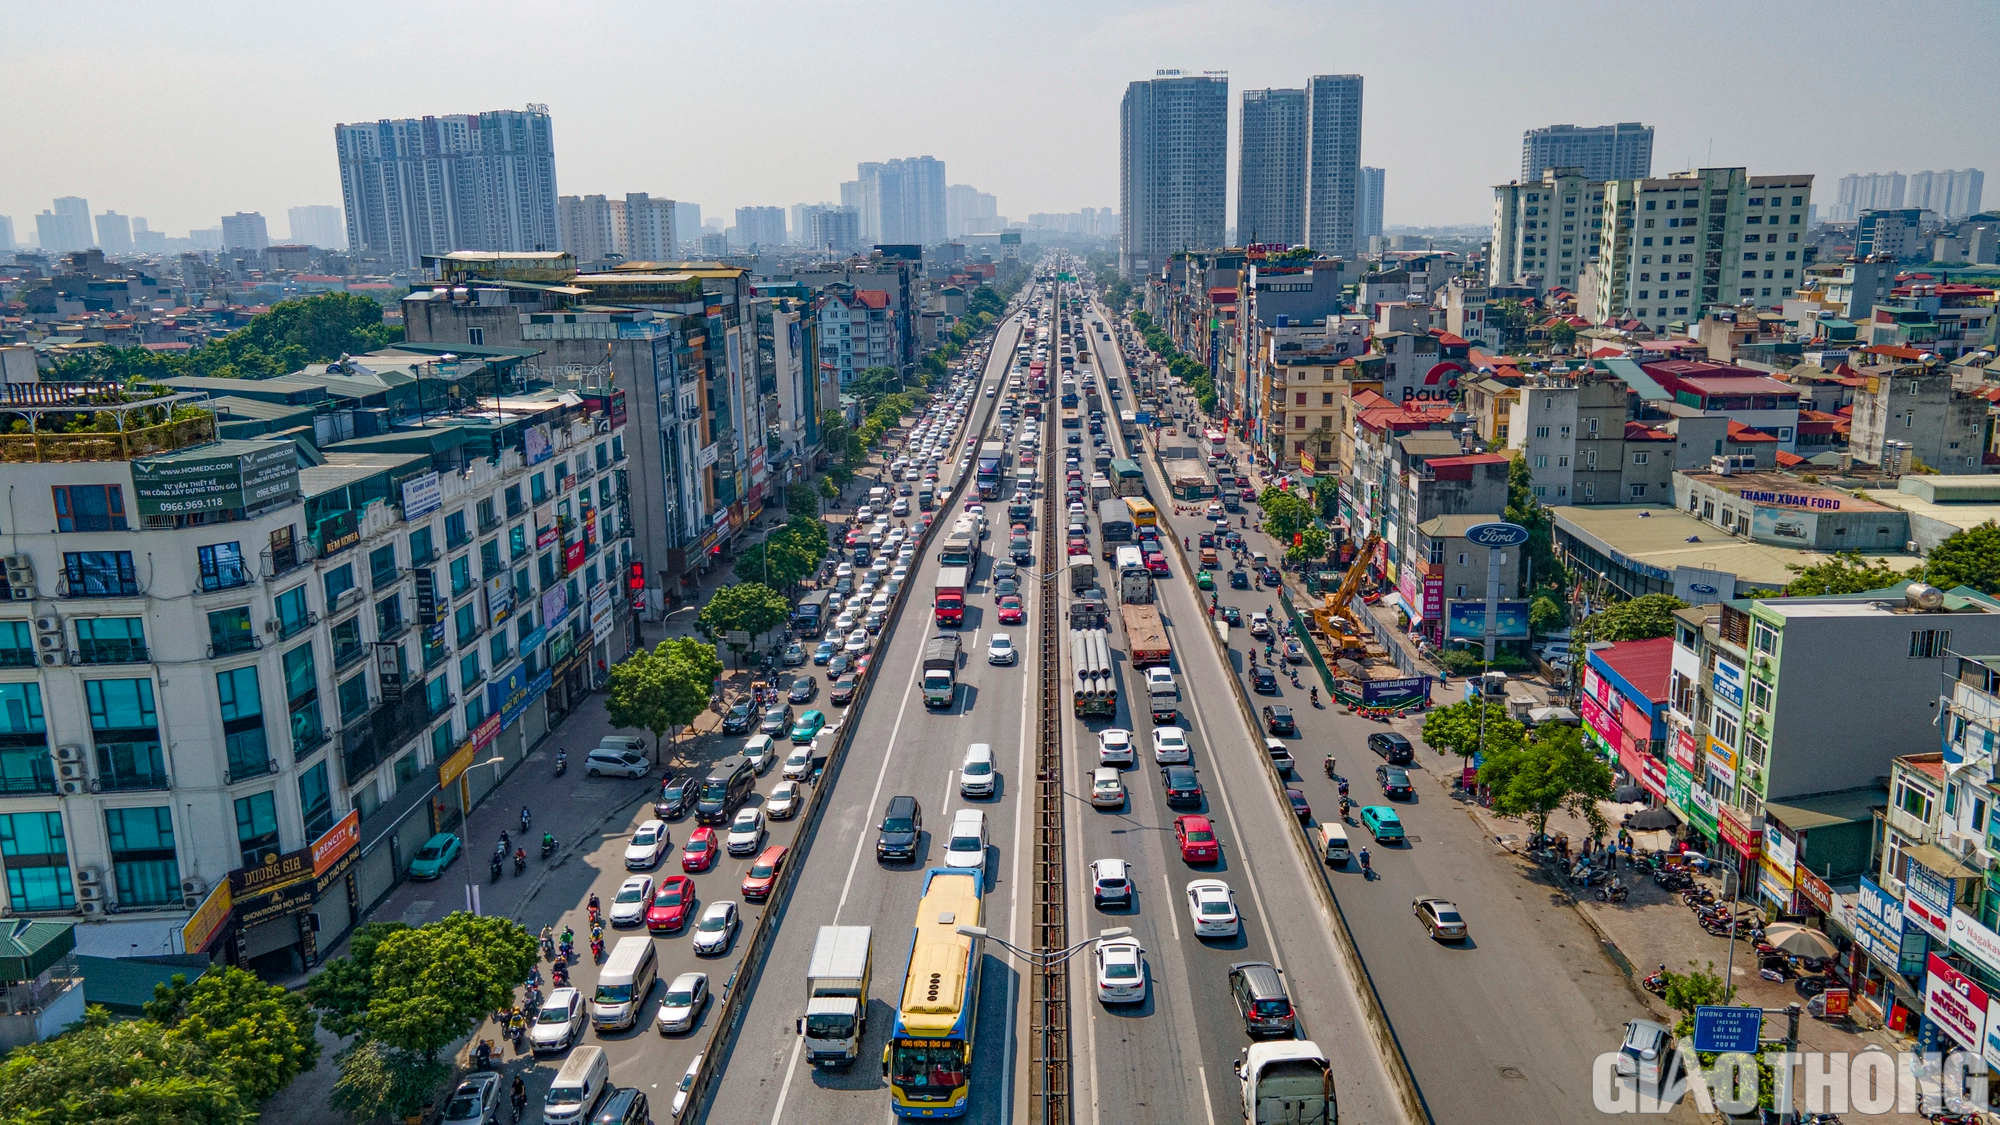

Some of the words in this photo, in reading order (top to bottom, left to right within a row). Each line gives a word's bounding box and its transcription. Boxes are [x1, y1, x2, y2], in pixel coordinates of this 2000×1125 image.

[1248, 244, 1288, 254] HOTEL
[1402, 386, 1468, 402] Bauer
[152, 488, 170, 496] CÔNG
[171, 486, 184, 496] XÂY
[186, 486, 206, 495] DỰNG
[206, 484, 224, 494] TRỌN
[226, 482, 238, 490] GÓI
[205, 478, 216, 486] KẾ
[256, 482, 290, 498] 0966.969.118
[160, 498, 223, 512] 0966.969.118
[1740, 490, 1776, 502] THANH
[1778, 494, 1808, 506] XUAN
[1811, 498, 1840, 510] FORD
[326, 540, 340, 553] RÈM
[341, 532, 359, 547] KOREA
[1478, 528, 1516, 542] Ford
[1645, 564, 1669, 580] FORD
[1692, 584, 1712, 593] Ford
[1388, 680, 1404, 688] XUÂN
[1711, 743, 1731, 760] MPE
[1669, 762, 1679, 776] VÂN
[1678, 770, 1690, 785] LONG
[282, 856, 302, 873] GIA
[316, 876, 330, 892] BÀN
[329, 866, 340, 882] THỜ
[349, 847, 360, 863] PHÚ
[1803, 878, 1829, 907] SAIGON
[242, 904, 282, 922] SHOWROOM
[283, 898, 294, 909] NỘI
[296, 892, 312, 904] THẤT
[1859, 884, 1882, 919] KHÓA
[1884, 902, 1902, 933] CỬA
[1856, 927, 1870, 948] 60
[1955, 977, 1970, 996] LG
[1931, 990, 1977, 1035] INVERTER
